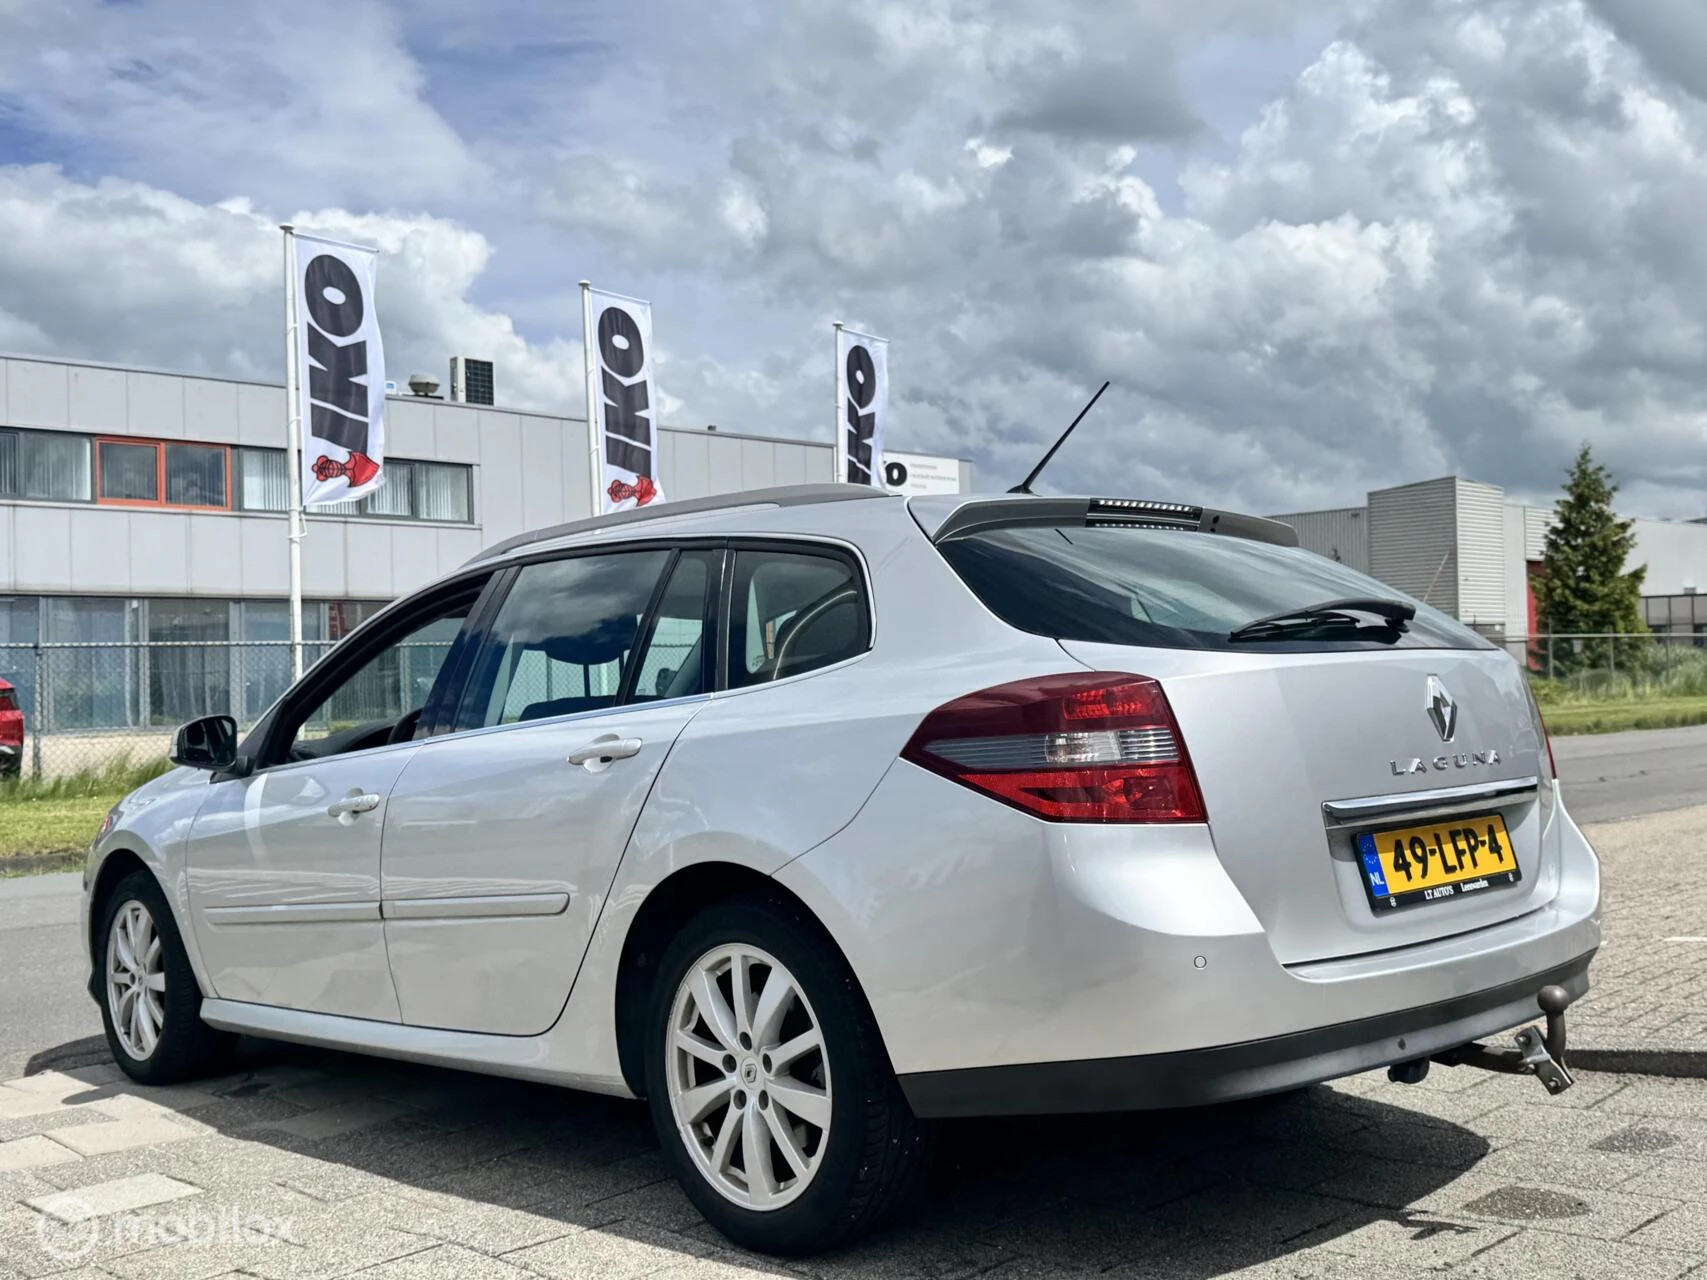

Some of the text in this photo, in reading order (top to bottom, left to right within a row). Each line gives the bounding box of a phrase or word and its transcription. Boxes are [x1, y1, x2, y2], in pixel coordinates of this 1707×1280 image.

[305, 254, 368, 453] IKO
[598, 306, 652, 478] IKO
[1390, 749, 1502, 776] LAGUNA
[1370, 871, 1385, 887] NL
[1392, 823, 1504, 882] 49-LFP-4
